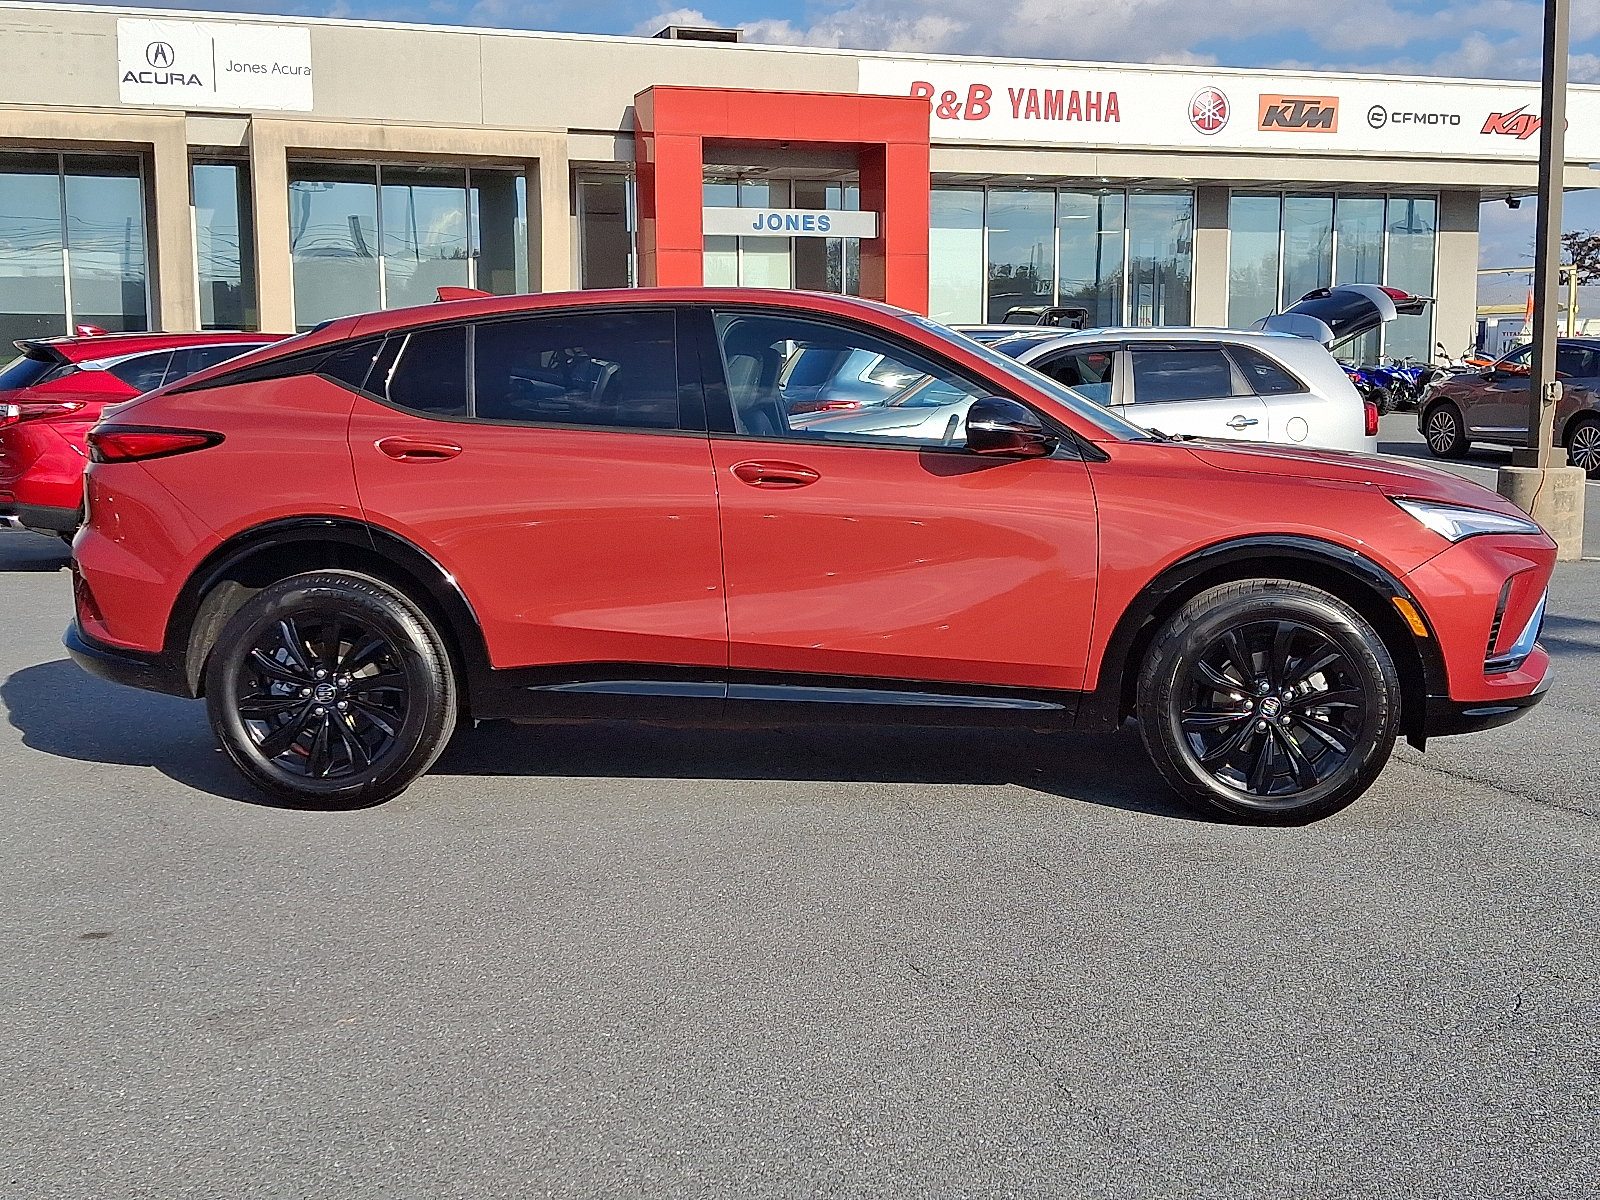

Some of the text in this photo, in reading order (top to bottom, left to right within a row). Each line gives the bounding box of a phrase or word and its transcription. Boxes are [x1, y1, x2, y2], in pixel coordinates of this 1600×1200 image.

[226, 60, 312, 76] Jones Acura
[122, 70, 203, 86] ACURA
[1008, 87, 1121, 122] YAMAHA
[1262, 99, 1335, 129] KTM
[1391, 112, 1461, 126] CFMOTO
[1480, 104, 1569, 140] KAY
[752, 213, 831, 232] JONES
